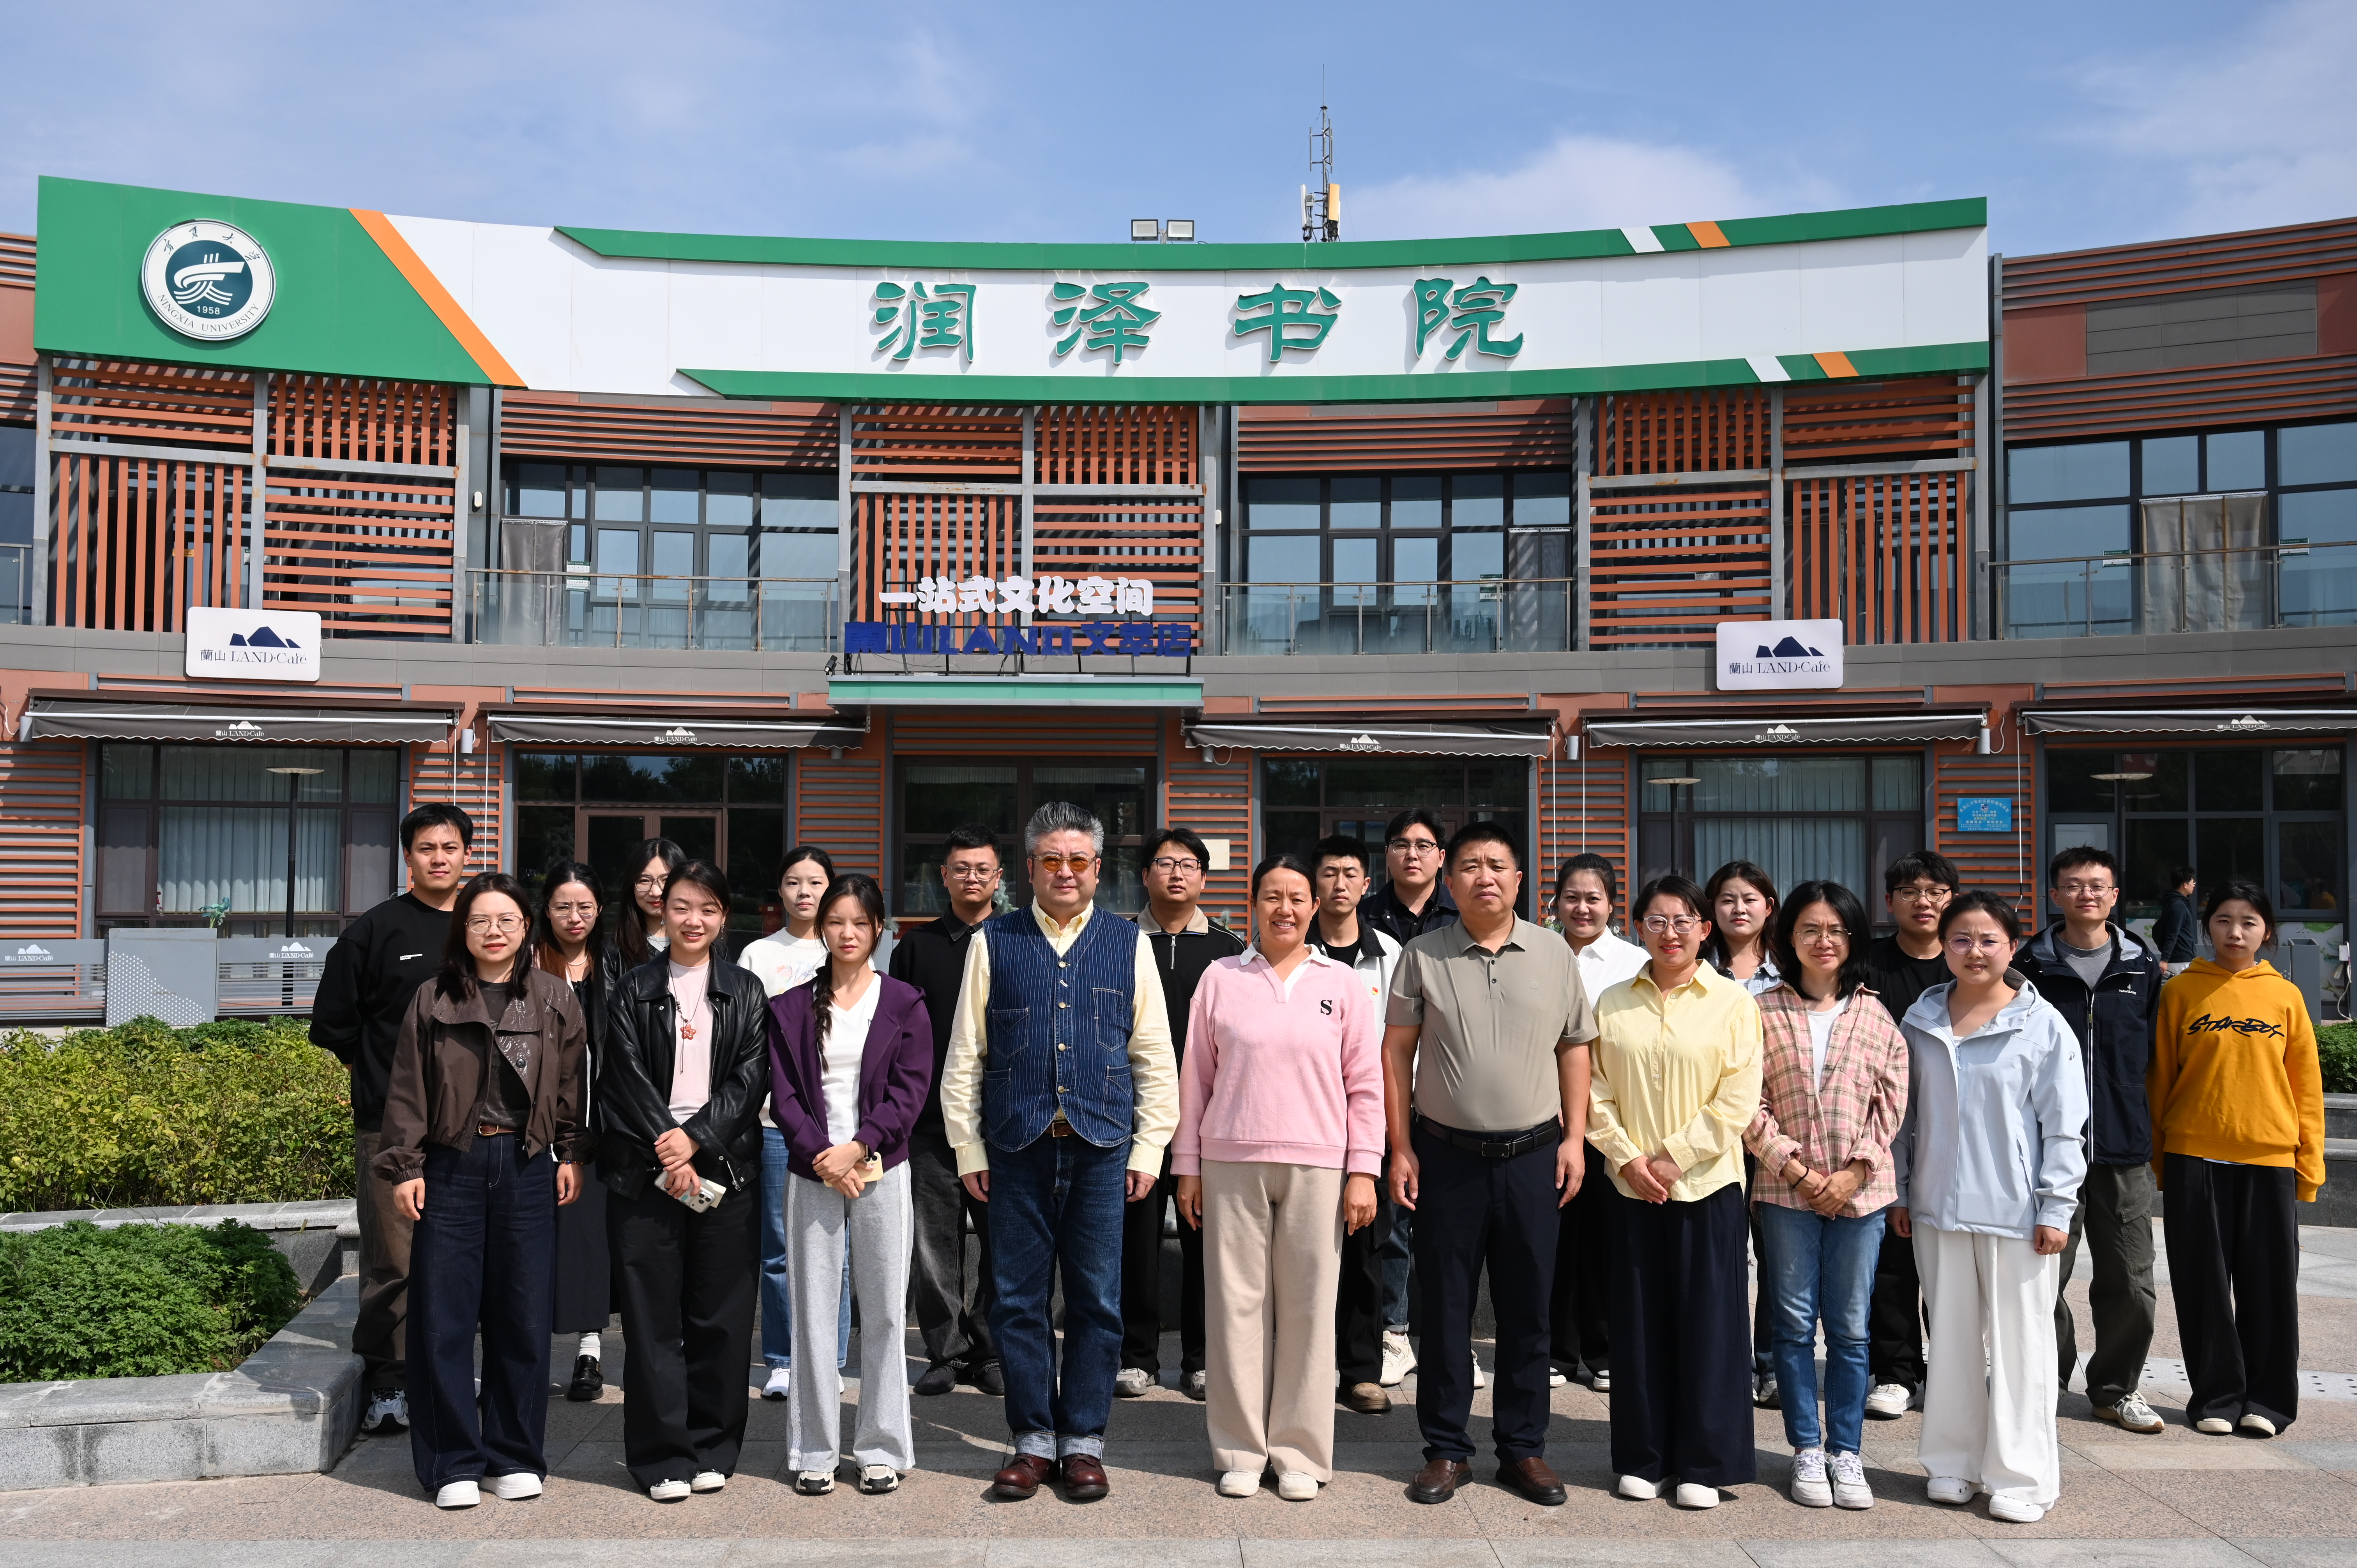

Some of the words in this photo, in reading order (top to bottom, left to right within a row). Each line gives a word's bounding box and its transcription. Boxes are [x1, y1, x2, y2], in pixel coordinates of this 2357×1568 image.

[158, 295, 194, 328] NINGXIA
[201, 304, 259, 332] UNIVERSITY
[197, 305, 220, 315] 1958
[875, 276, 1524, 364] 润泽书院
[878, 576, 1153, 616] 一站式文化空间
[200, 649, 226, 662] 蘭山
[1729, 662, 1753, 675] 蘭山
[1320, 1000, 1332, 1015] S
